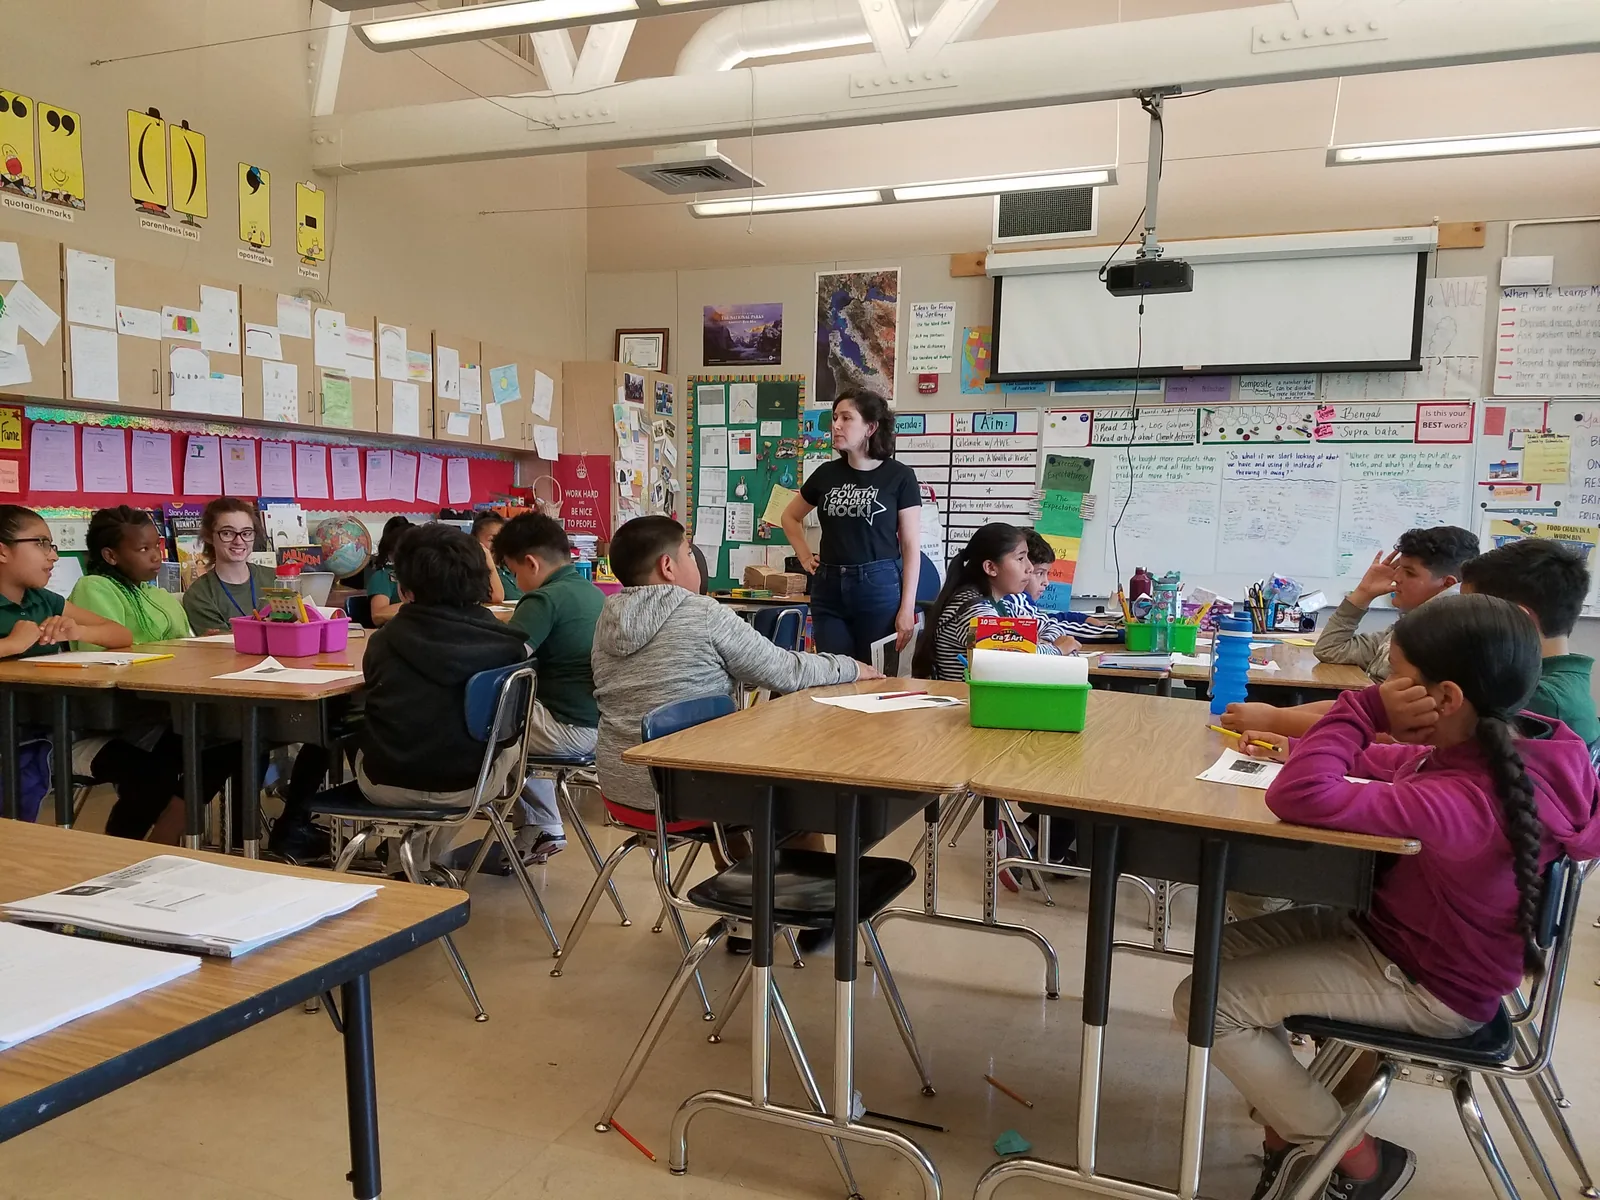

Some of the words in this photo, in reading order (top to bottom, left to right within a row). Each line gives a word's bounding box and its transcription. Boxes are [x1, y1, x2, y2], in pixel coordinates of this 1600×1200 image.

[4, 198, 45, 214] quotation
[47, 208, 72, 220] marks
[141, 219, 182, 235] parenthesis
[239, 251, 272, 264] apostrophe
[299, 268, 319, 278] hyphen
[1503, 288, 1529, 299] When
[1533, 287, 1553, 299] Yale
[1558, 287, 1588, 298] Learns
[912, 304, 929, 312] Ideas
[1520, 304, 1547, 313] Errors
[1566, 345, 1597, 356] thinking
[1516, 357, 1543, 367] Respond
[1239, 379, 1273, 389] Composite
[1449, 411, 1466, 419] your
[895, 417, 922, 434] genda:
[980, 416, 1008, 430] Aim:
[1100, 423, 1118, 432] Read
[1422, 421, 1442, 429] BEST
[1444, 421, 1468, 429] work?
[1, 420, 20, 443] Fame
[1099, 434, 1116, 442] Read
[955, 454, 975, 464] Reflect
[1138, 454, 1157, 465] bought
[1176, 454, 1200, 465] products
[1203, 454, 1217, 462] than
[1241, 451, 1256, 460] what
[1278, 452, 1293, 460] start
[1295, 452, 1315, 462] looking
[1317, 452, 1324, 460] at
[1400, 452, 1417, 461] going
[1427, 451, 1438, 461] put
[1196, 463, 1215, 472] buying
[1267, 461, 1282, 470] using
[1293, 461, 1315, 469] instead
[1416, 461, 1432, 470] doing
[954, 469, 977, 481] Journey
[1235, 469, 1260, 477] throwing
[565, 489, 582, 498] WORK
[583, 490, 599, 499] HARD
[830, 489, 876, 499] FOURTH
[1055, 494, 1069, 503] The
[829, 497, 872, 505] GRADERS
[168, 508, 183, 517] Story
[571, 507, 578, 516] BE
[579, 508, 592, 516] NICE
[827, 504, 872, 518] ROCK!
[567, 519, 575, 528] TO
[576, 519, 597, 528] PEOPLE
[1546, 524, 1561, 532] FOOD
[1562, 525, 1578, 533] CHAIN
[1553, 532, 1571, 540] WORM
[1571, 533, 1581, 541] BIN
[282, 549, 321, 566] MILLION
